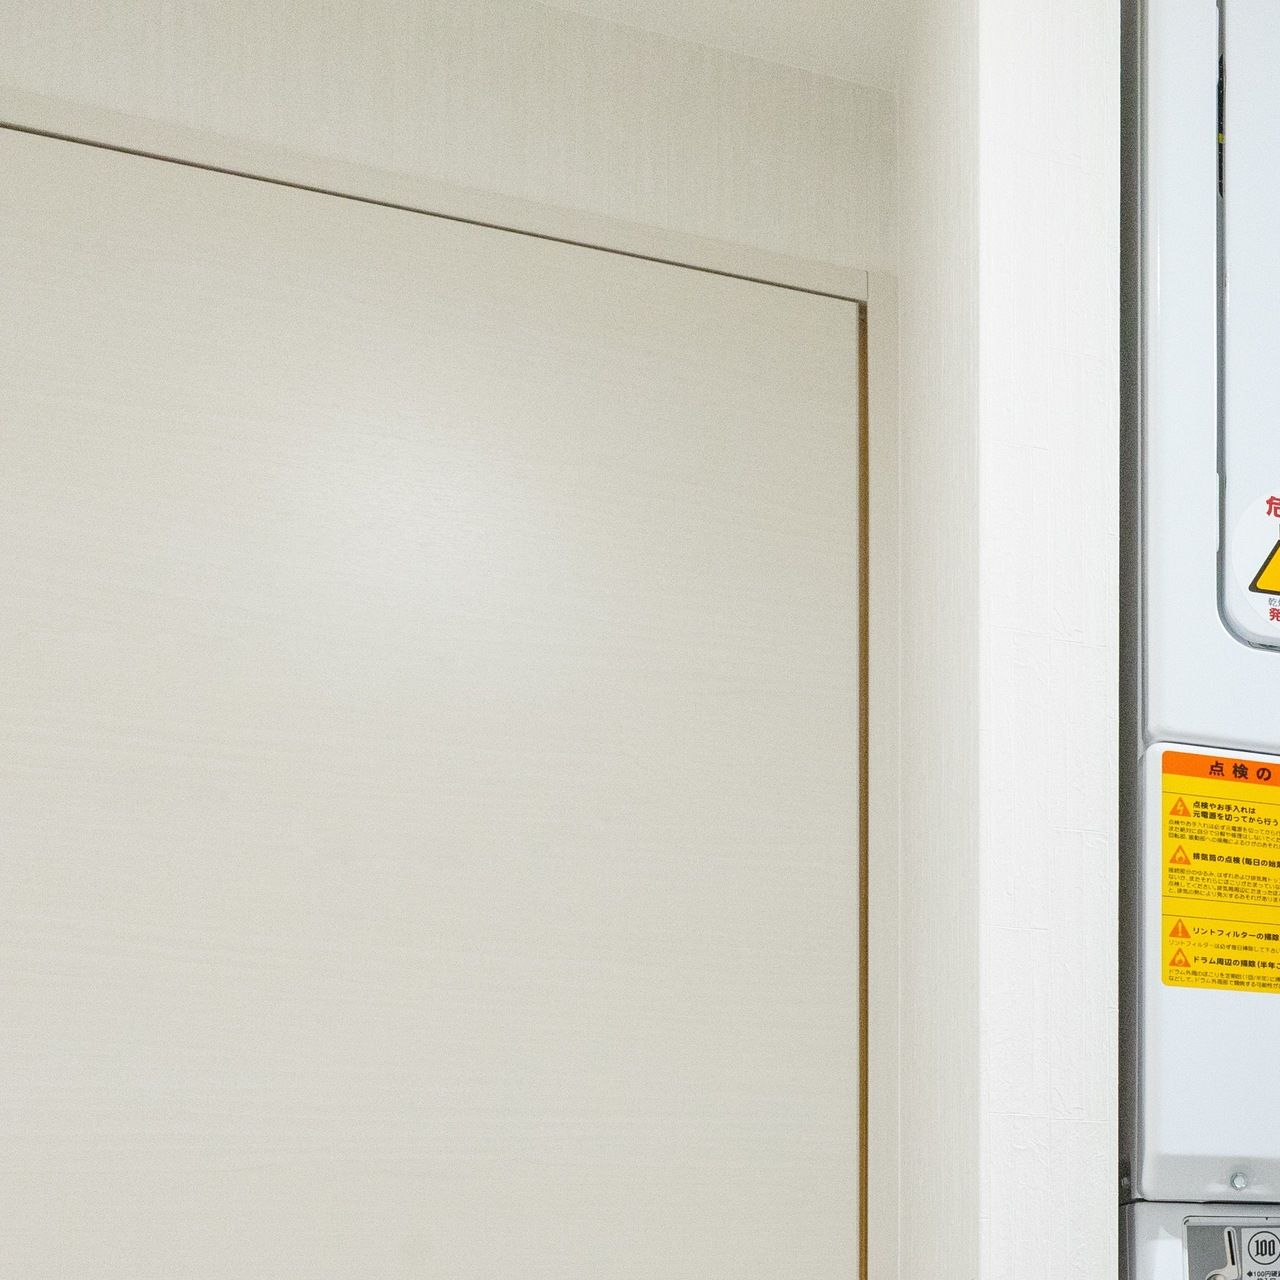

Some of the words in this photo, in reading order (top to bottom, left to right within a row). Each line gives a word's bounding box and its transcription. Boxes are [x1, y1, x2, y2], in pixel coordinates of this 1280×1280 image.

[1193, 801, 1256, 815] 点検やお手入れは
[1255, 1240, 1275, 1256] 100
